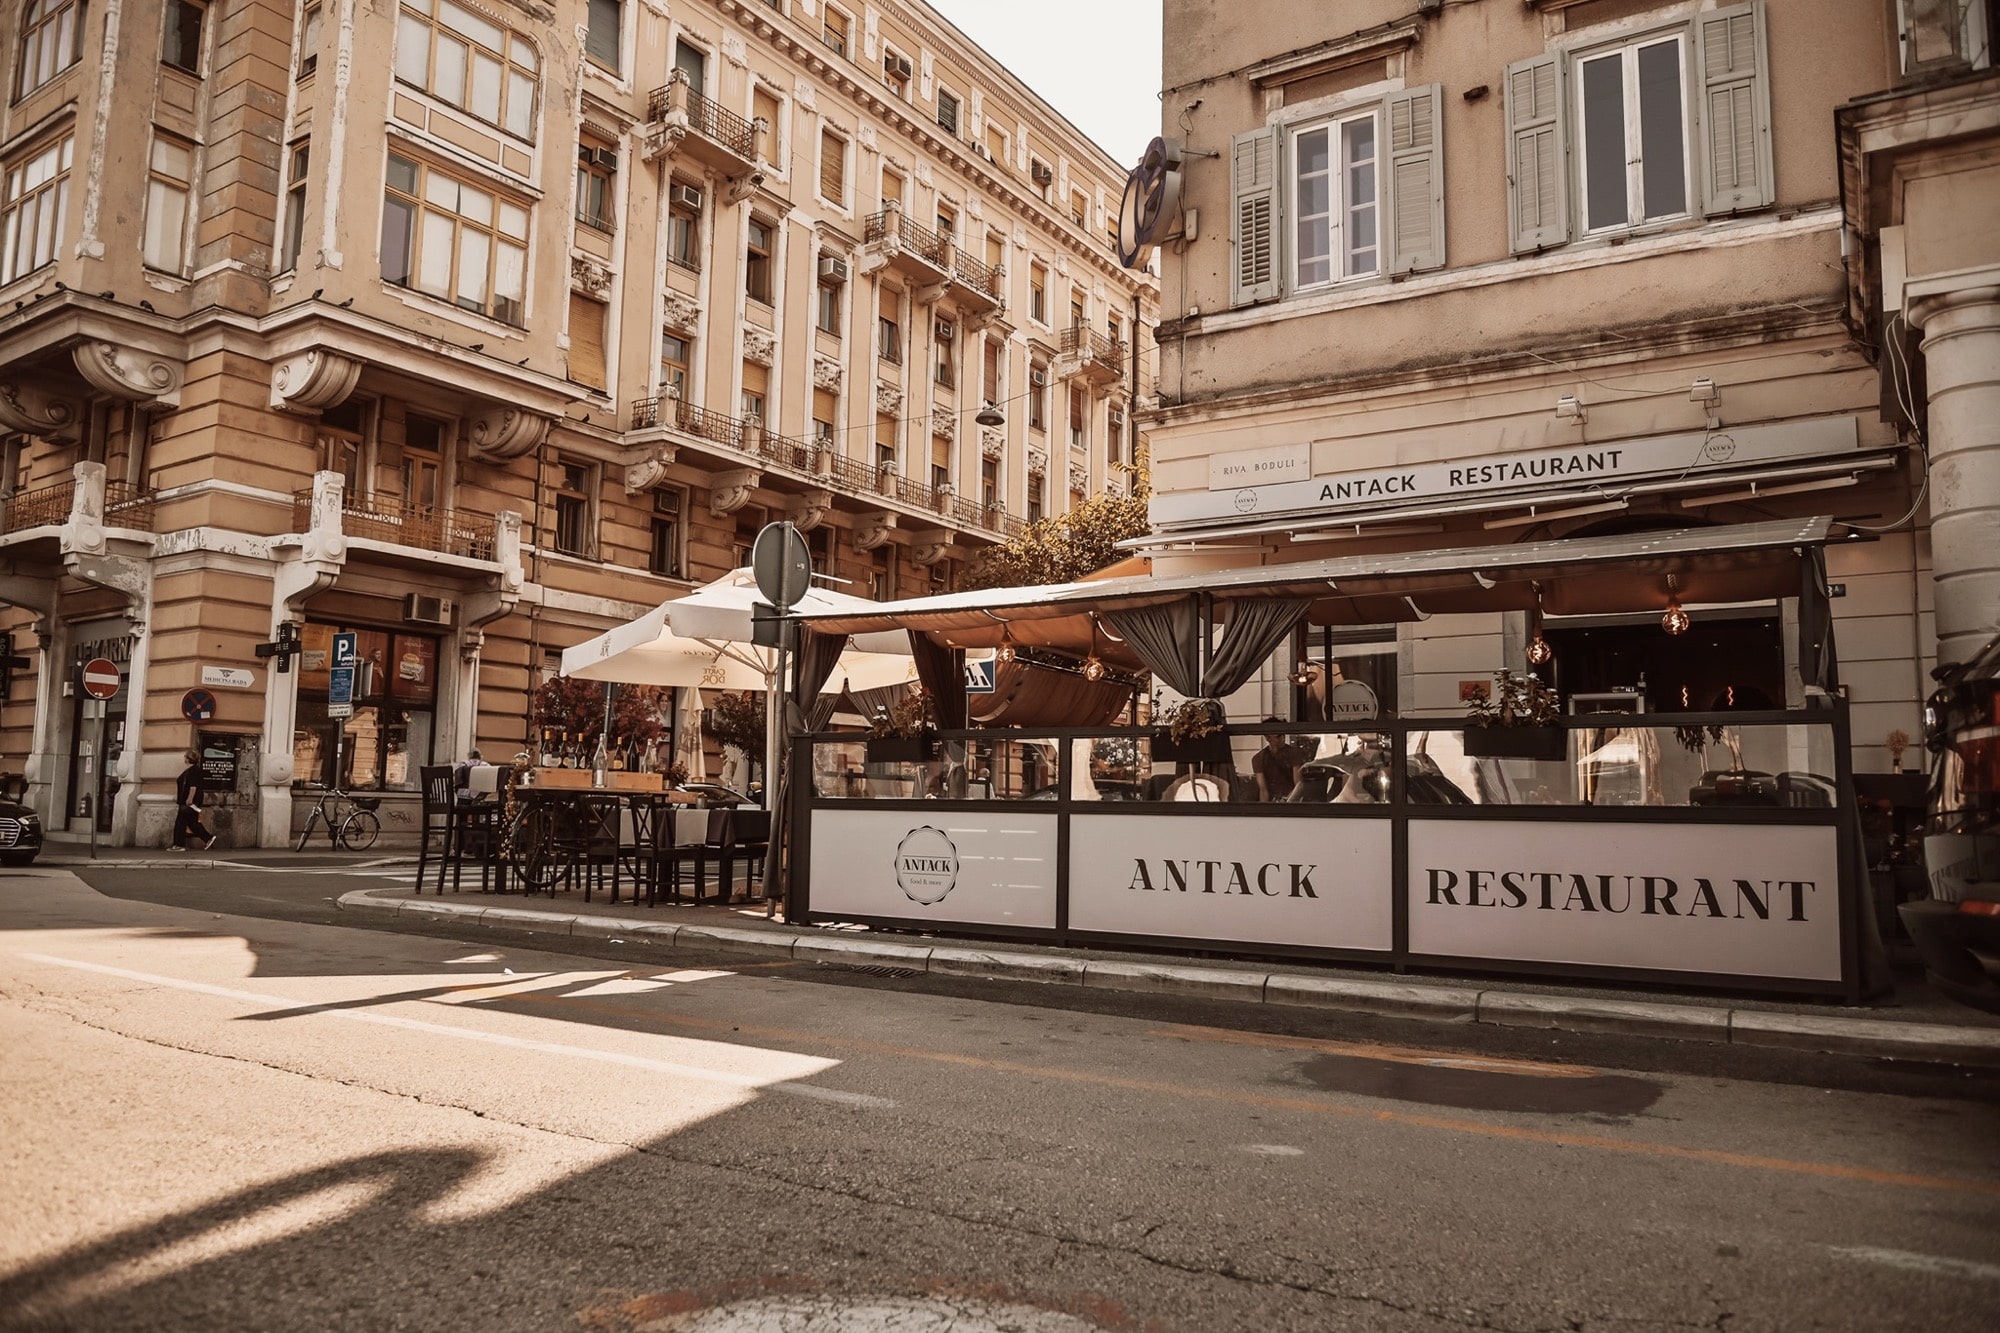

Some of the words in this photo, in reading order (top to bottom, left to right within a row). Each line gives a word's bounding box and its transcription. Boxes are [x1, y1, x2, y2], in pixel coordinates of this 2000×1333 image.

[1223, 465, 1247, 475] RIVA
[1254, 459, 1295, 472] BODULI
[1319, 474, 1416, 501] ANTACK
[1449, 450, 1622, 487] RESTAURANT
[337, 639, 349, 661] P
[1333, 703, 1369, 712] ANTACK
[903, 859, 951, 873] ANTACK
[923, 878, 928, 886] &
[1128, 858, 1319, 899] ANTACK
[1425, 868, 1816, 922] RESTAURANT
